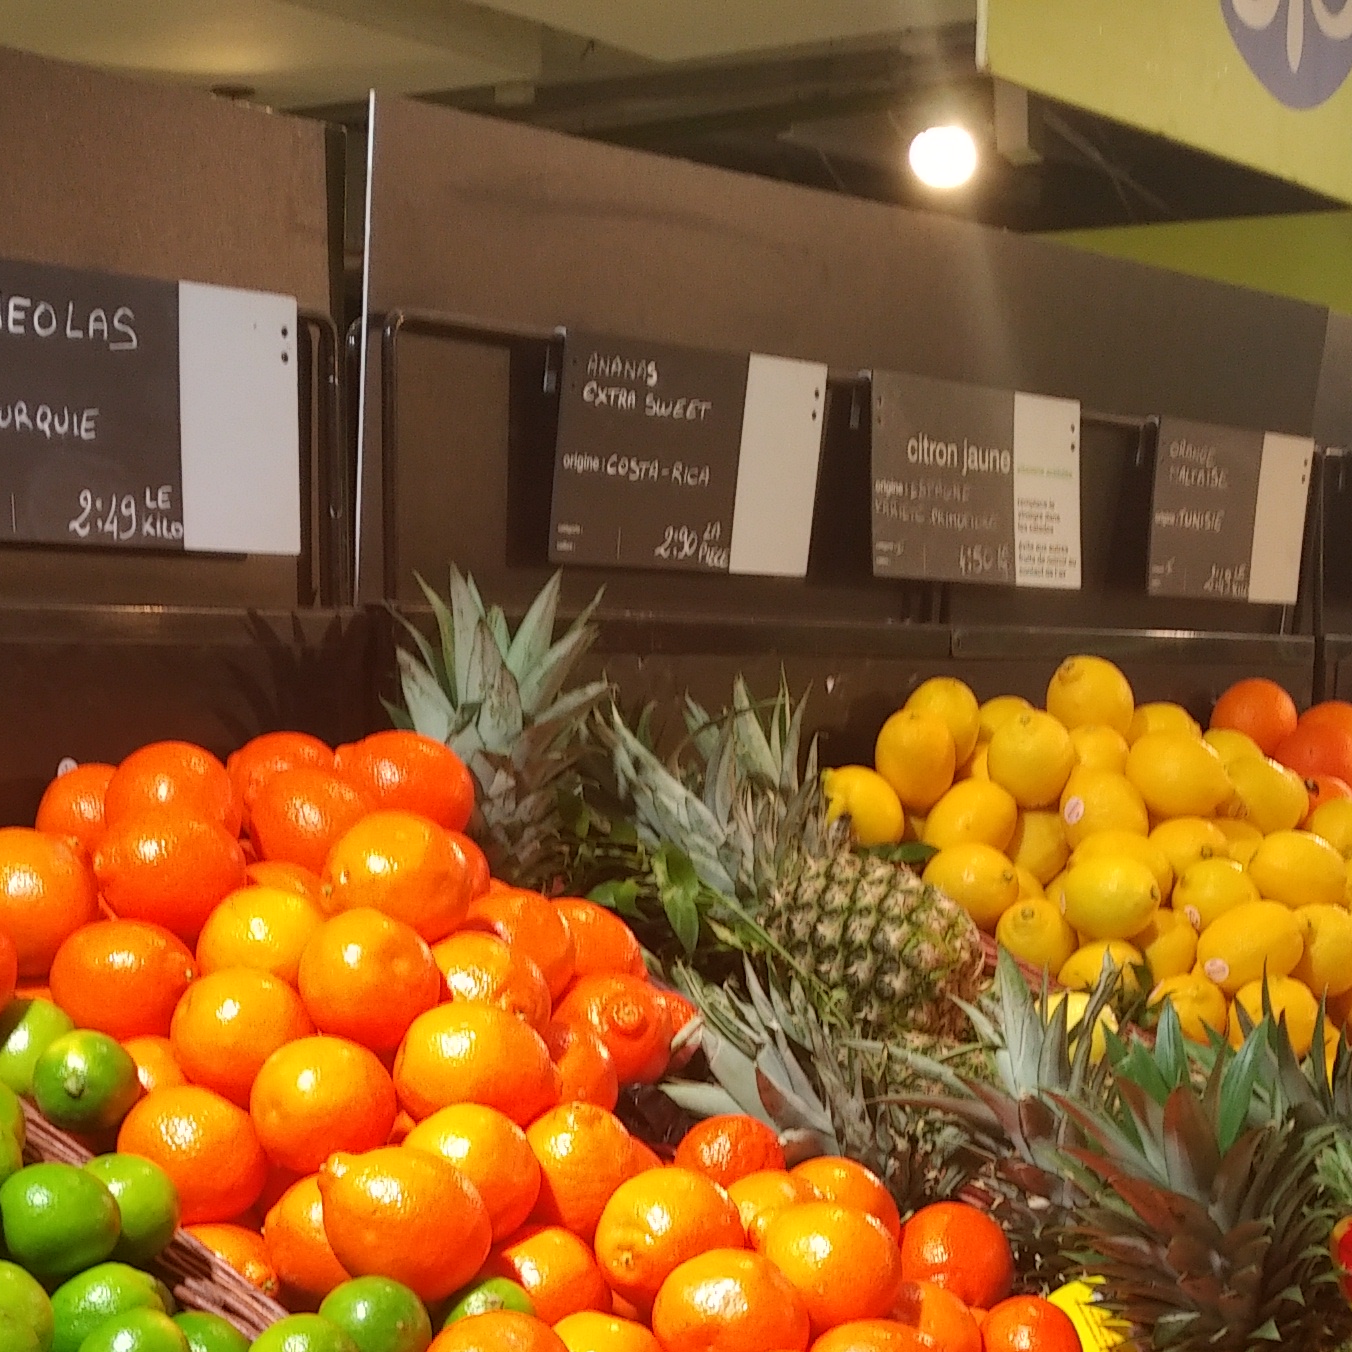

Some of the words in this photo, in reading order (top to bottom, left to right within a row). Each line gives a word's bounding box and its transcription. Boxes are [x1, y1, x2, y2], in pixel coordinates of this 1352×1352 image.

[586, 352, 659, 387] ANANAS
[582, 380, 637, 408] EXTRA
[644, 392, 712, 421] SWEET
[907, 432, 958, 468] citron
[961, 437, 1011, 477] jaune
[145, 484, 173, 510] LE
